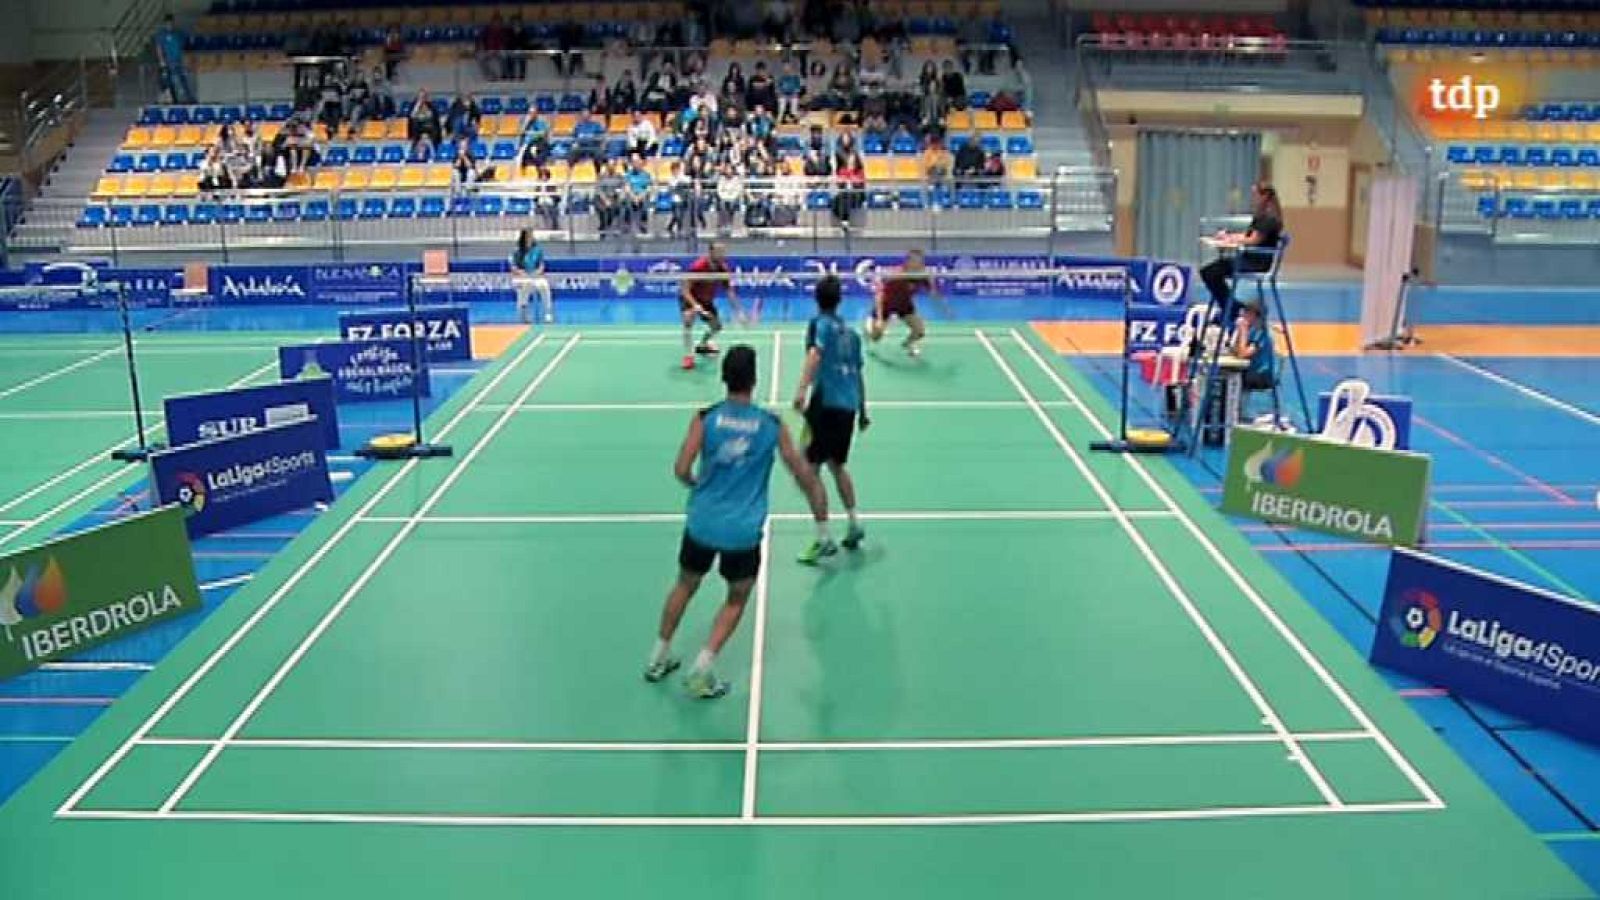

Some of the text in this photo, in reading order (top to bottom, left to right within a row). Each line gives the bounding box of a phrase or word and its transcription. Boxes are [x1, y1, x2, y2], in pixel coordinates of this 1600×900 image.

[381, 319, 462, 340] FORZA
[1130, 321, 1158, 342] FZ
[1251, 490, 1394, 539] IBERDROLA
[21, 584, 182, 661] IBERDROLA
[1447, 609, 1600, 683] LaLiga4Spor
